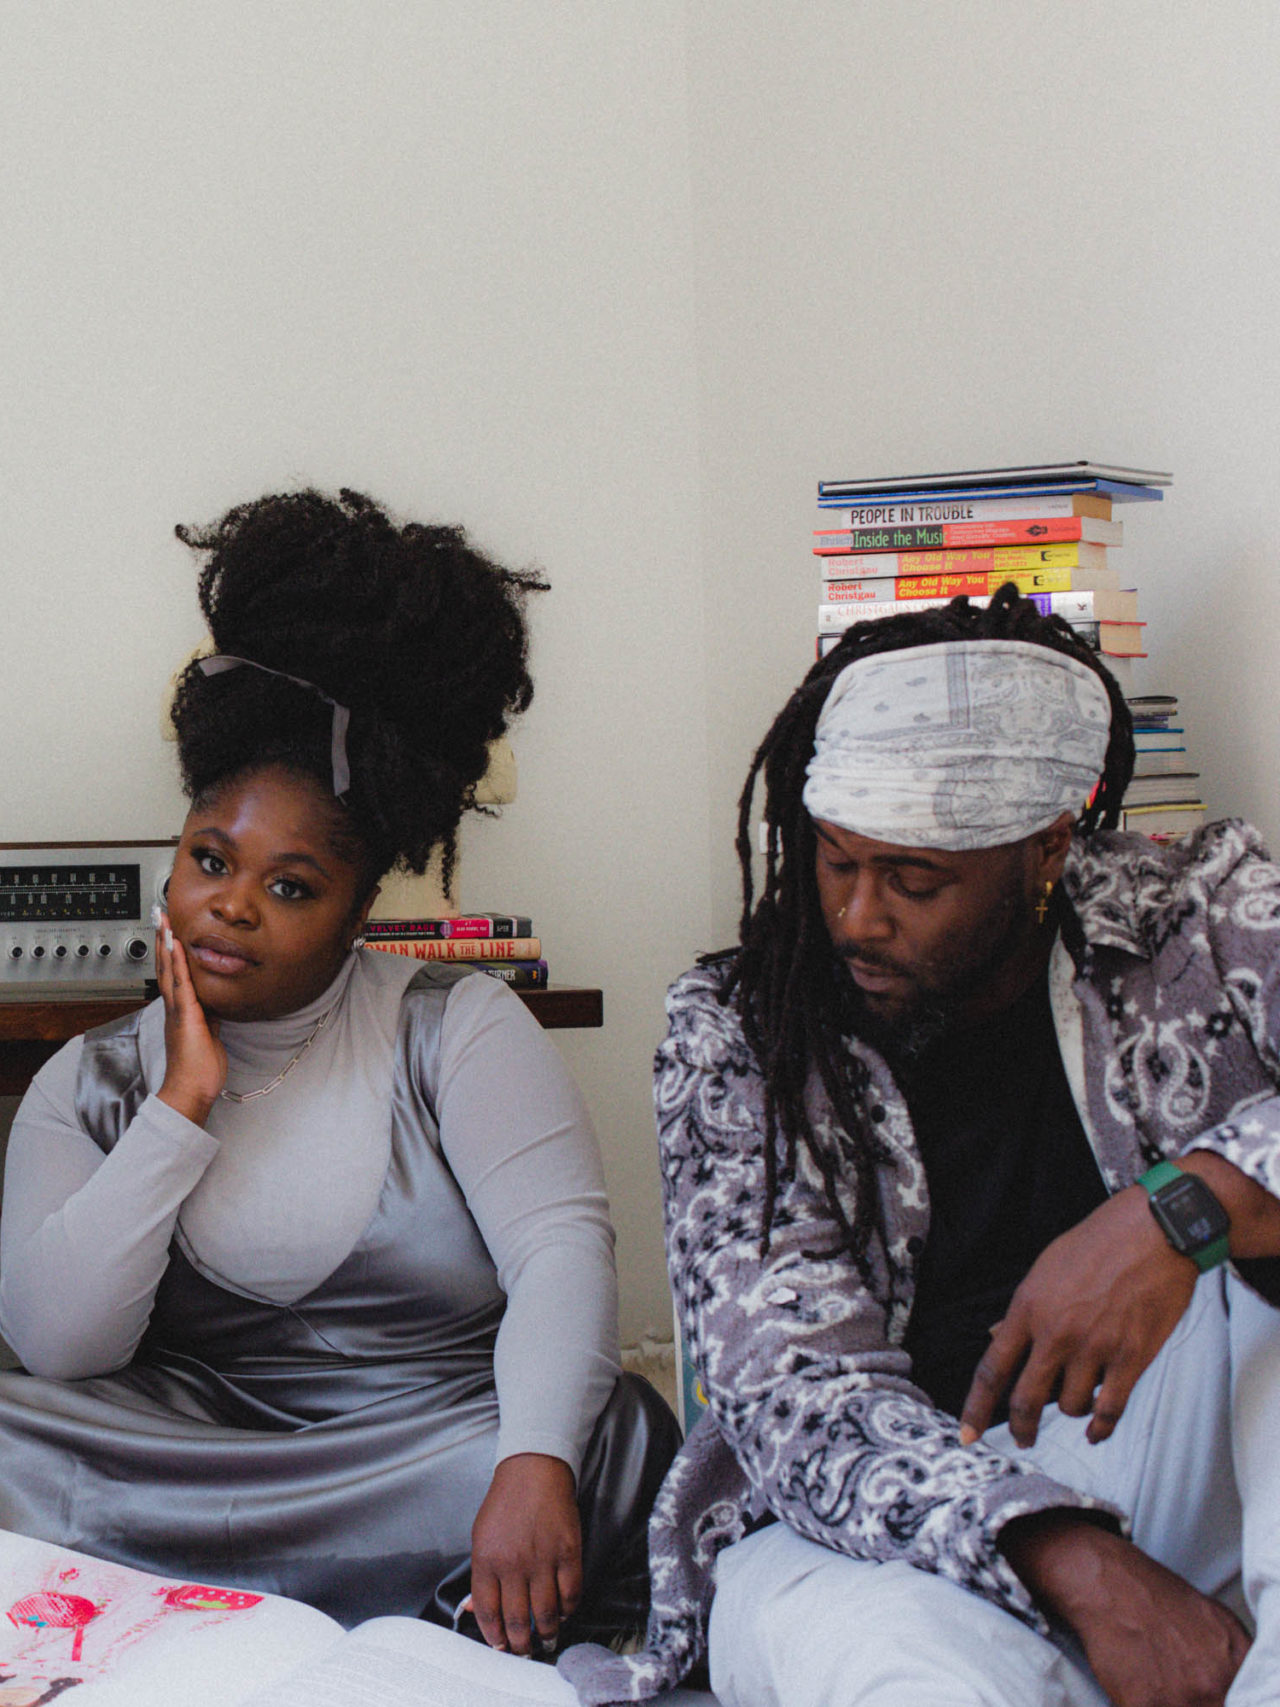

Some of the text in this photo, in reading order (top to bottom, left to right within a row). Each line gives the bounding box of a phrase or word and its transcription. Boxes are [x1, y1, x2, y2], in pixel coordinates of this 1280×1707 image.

[851, 508, 895, 524] PEOPLE
[900, 507, 914, 522] IN
[919, 504, 974, 521] TROUBLE
[854, 531, 889, 548] Inside
[893, 530, 912, 546] the
[916, 527, 948, 545] Music
[828, 558, 864, 568] Robert
[901, 550, 991, 565] Any Old Way You
[828, 567, 878, 577] Christgau
[902, 563, 942, 573] Choose
[828, 582, 862, 591] Robert
[899, 576, 984, 589] Any Old Way You
[828, 590, 876, 601] Christgau
[899, 586, 948, 597] Choose It
[413, 942, 456, 959] WALK
[460, 944, 476, 956] THE
[480, 941, 515, 959] LINE
